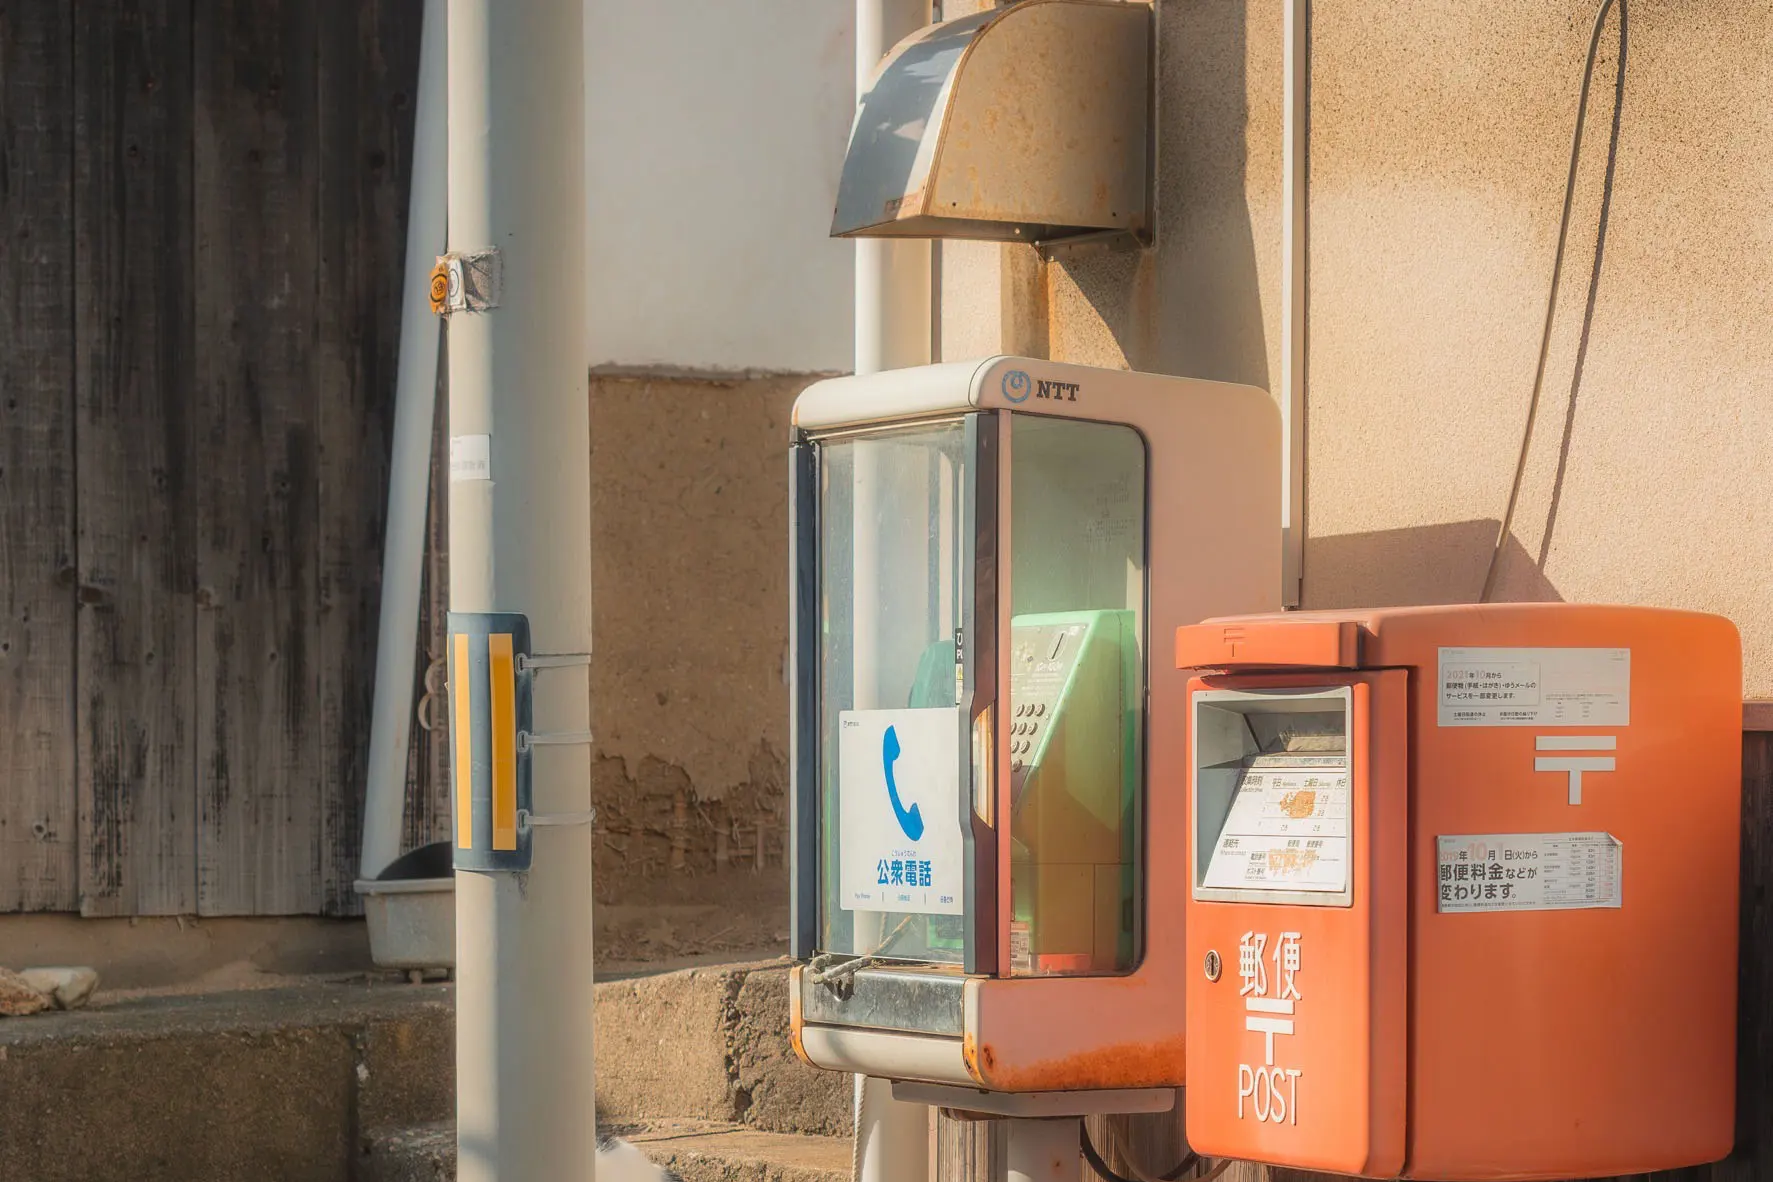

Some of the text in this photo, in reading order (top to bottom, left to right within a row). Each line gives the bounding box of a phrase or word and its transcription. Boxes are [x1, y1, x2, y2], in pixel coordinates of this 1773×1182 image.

[1036, 380, 1080, 401] NTT
[877, 859, 931, 887] 公衆電話
[1440, 863, 1538, 881] 郵便料金などが
[1441, 883, 1517, 901] 変わります。
[1239, 930, 1302, 1000] 郵便
[1238, 1063, 1303, 1126] POST
